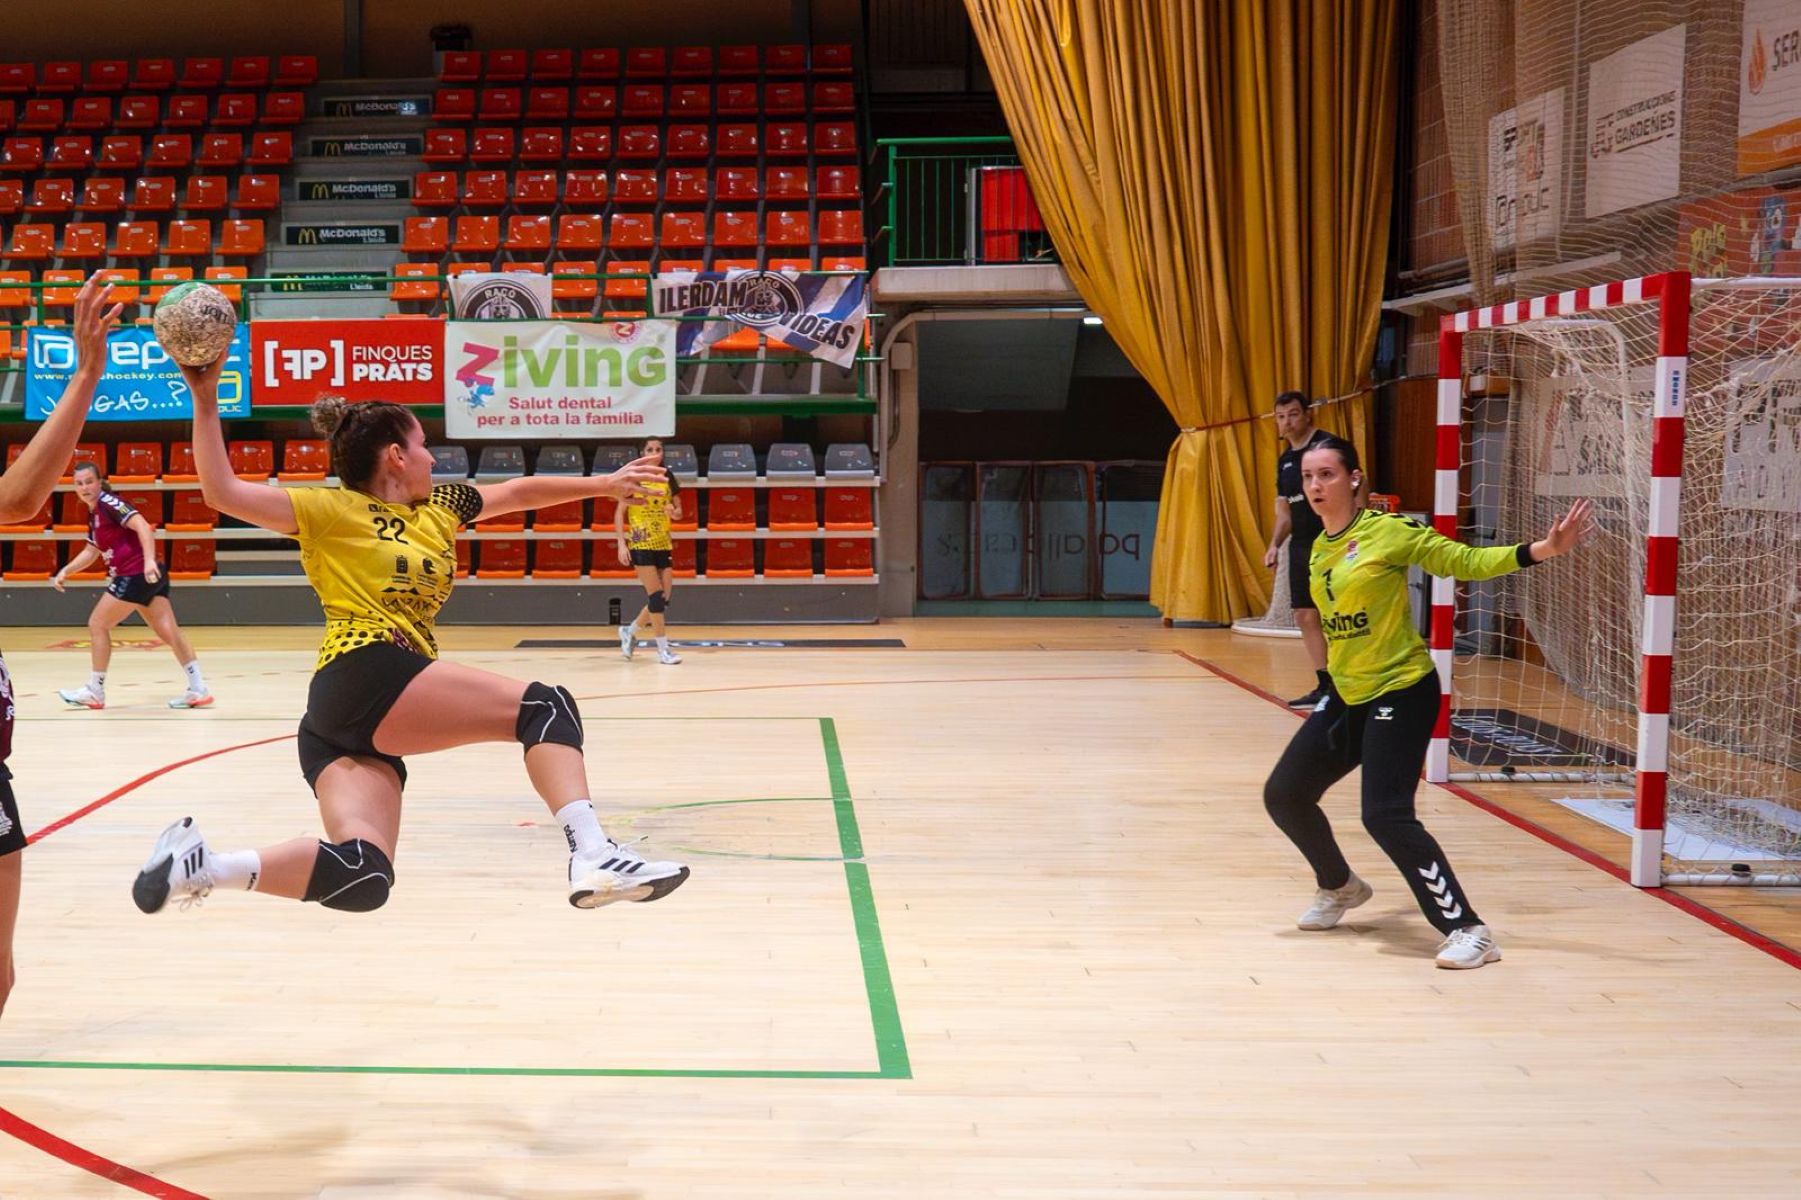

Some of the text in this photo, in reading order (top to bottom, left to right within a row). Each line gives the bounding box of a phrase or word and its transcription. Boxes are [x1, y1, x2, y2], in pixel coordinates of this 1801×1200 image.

[332, 184, 397, 193] McDonald's
[319, 228, 386, 238] McDonald's
[659, 281, 750, 314] ILERDAM
[779, 313, 855, 349] VIDEAS
[352, 345, 433, 362] FINQUES
[352, 362, 433, 382] PRATS
[509, 396, 612, 409] Salut dental
[477, 414, 504, 428] per
[510, 414, 520, 425] a
[525, 413, 560, 425] tota
[565, 412, 581, 425] la
[373, 517, 408, 545] 22
